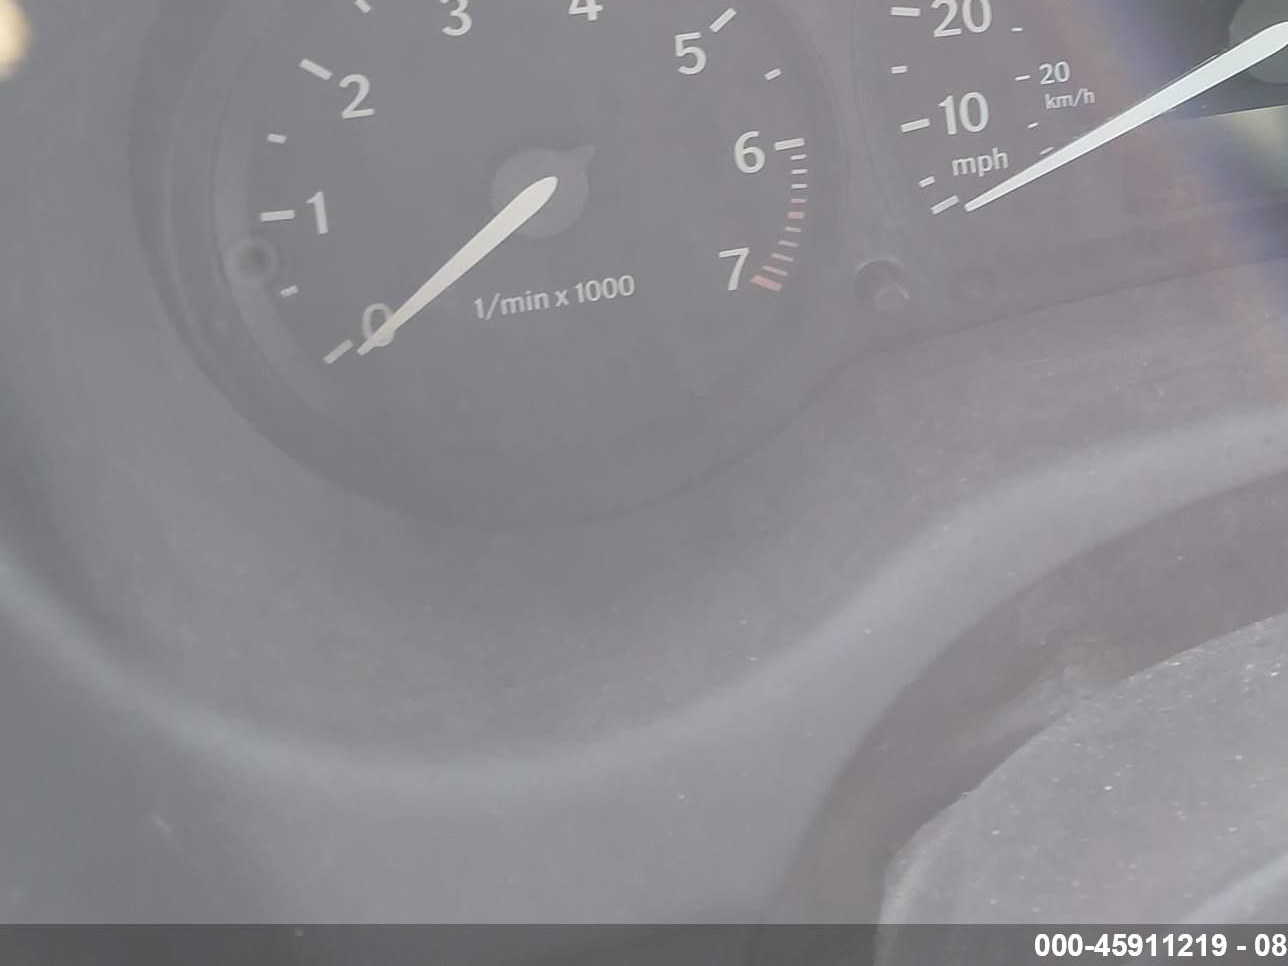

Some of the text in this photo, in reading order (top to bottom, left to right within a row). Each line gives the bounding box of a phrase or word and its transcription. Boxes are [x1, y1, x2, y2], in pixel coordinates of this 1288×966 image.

[675, 32, 706, 75] 5
[1039, 61, 1071, 85] 20
[339, 74, 374, 119] 2
[938, 92, 989, 135] 10
[1045, 88, 1095, 110] km/h
[734, 131, 765, 173] 6
[952, 148, 1008, 176] mph
[306, 191, 328, 234] 1
[719, 247, 750, 291] 7
[474, 275, 635, 321] 1/min x 1000
[361, 303, 396, 347] 0
